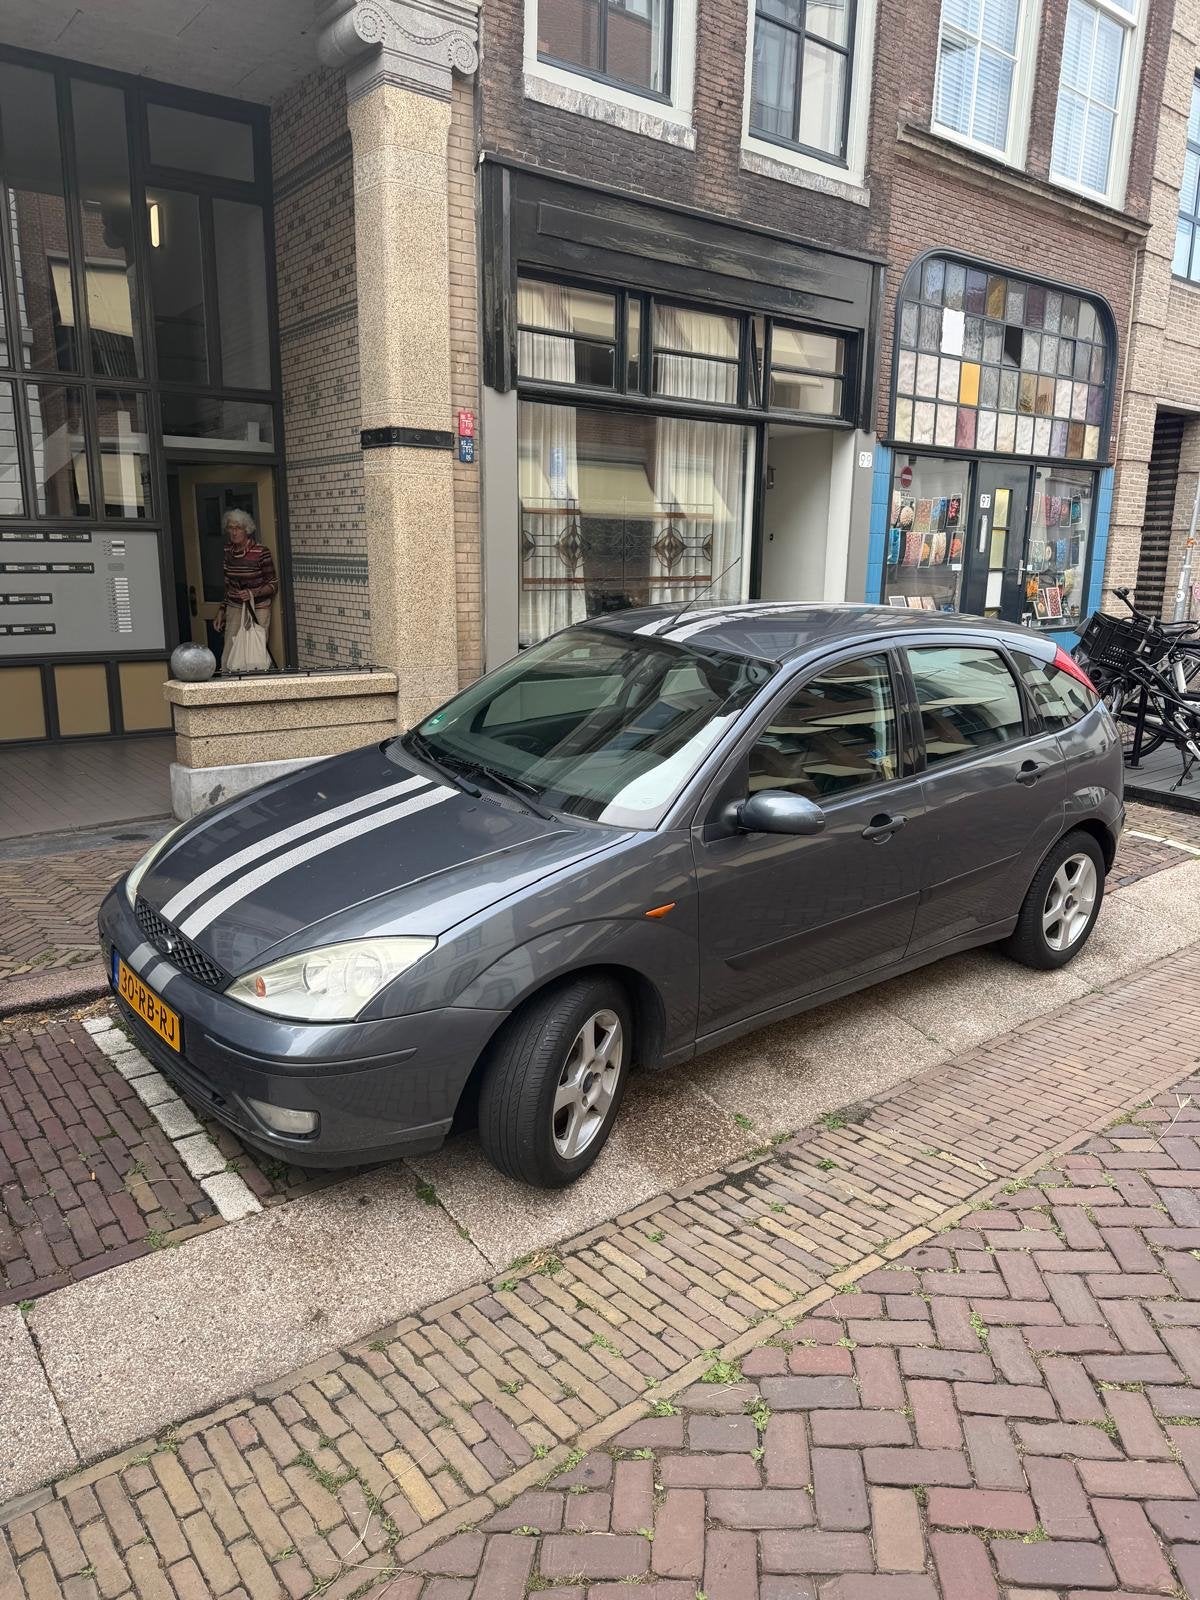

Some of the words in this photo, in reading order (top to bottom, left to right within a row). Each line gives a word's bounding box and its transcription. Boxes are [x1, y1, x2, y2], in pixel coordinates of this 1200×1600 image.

[860, 454, 871, 466] 99
[981, 496, 990, 506] 97
[121, 967, 175, 1041] 30-RB-RJ
